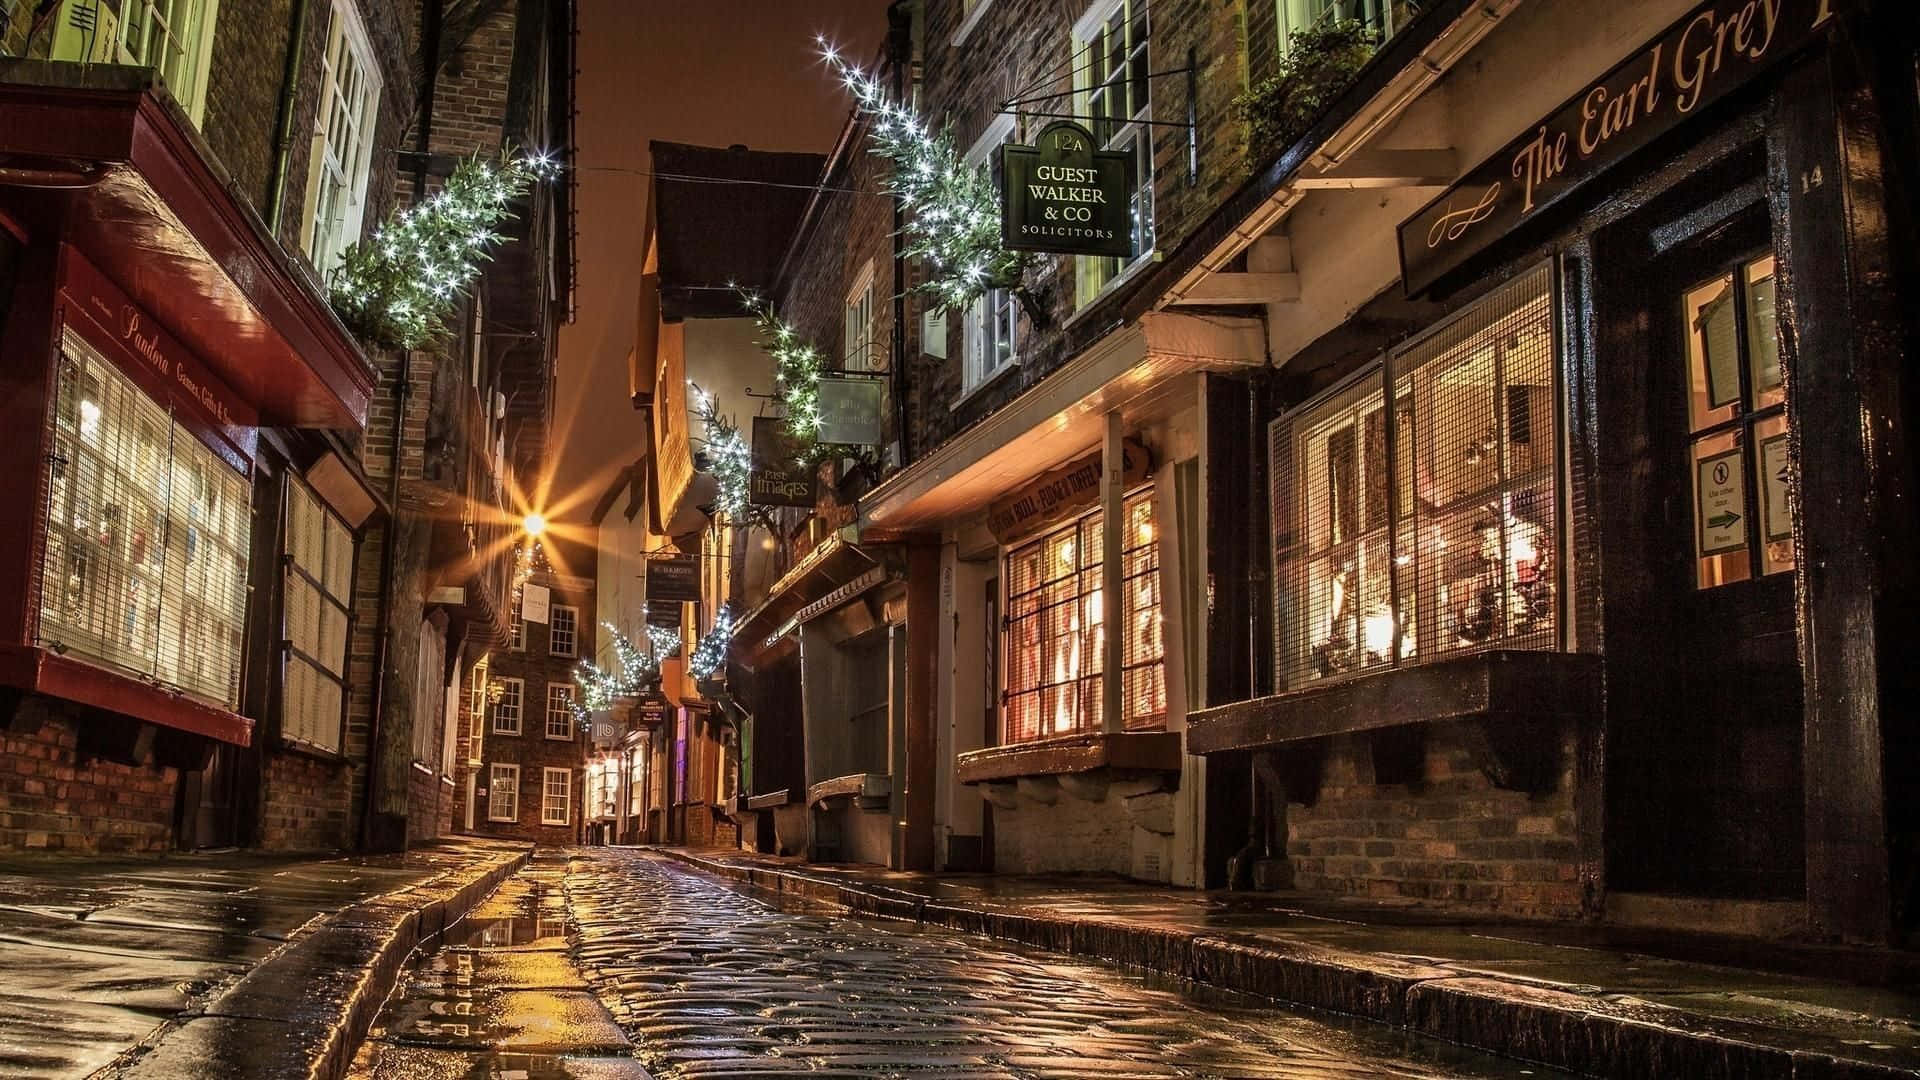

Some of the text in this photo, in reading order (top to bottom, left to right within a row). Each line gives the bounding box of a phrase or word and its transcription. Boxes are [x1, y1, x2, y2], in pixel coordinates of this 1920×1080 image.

[1512, 0, 1782, 214] The Earl Grey
[1054, 134, 1083, 151] 12A
[1037, 165, 1098, 184] GUEST
[1802, 163, 1825, 195] 14
[1028, 184, 1107, 204] WALKER
[1044, 206, 1092, 222] & CO
[1022, 224, 1113, 240] SOLICITORS
[121, 303, 169, 376] Pandora
[1013, 495, 1039, 523] BULL
